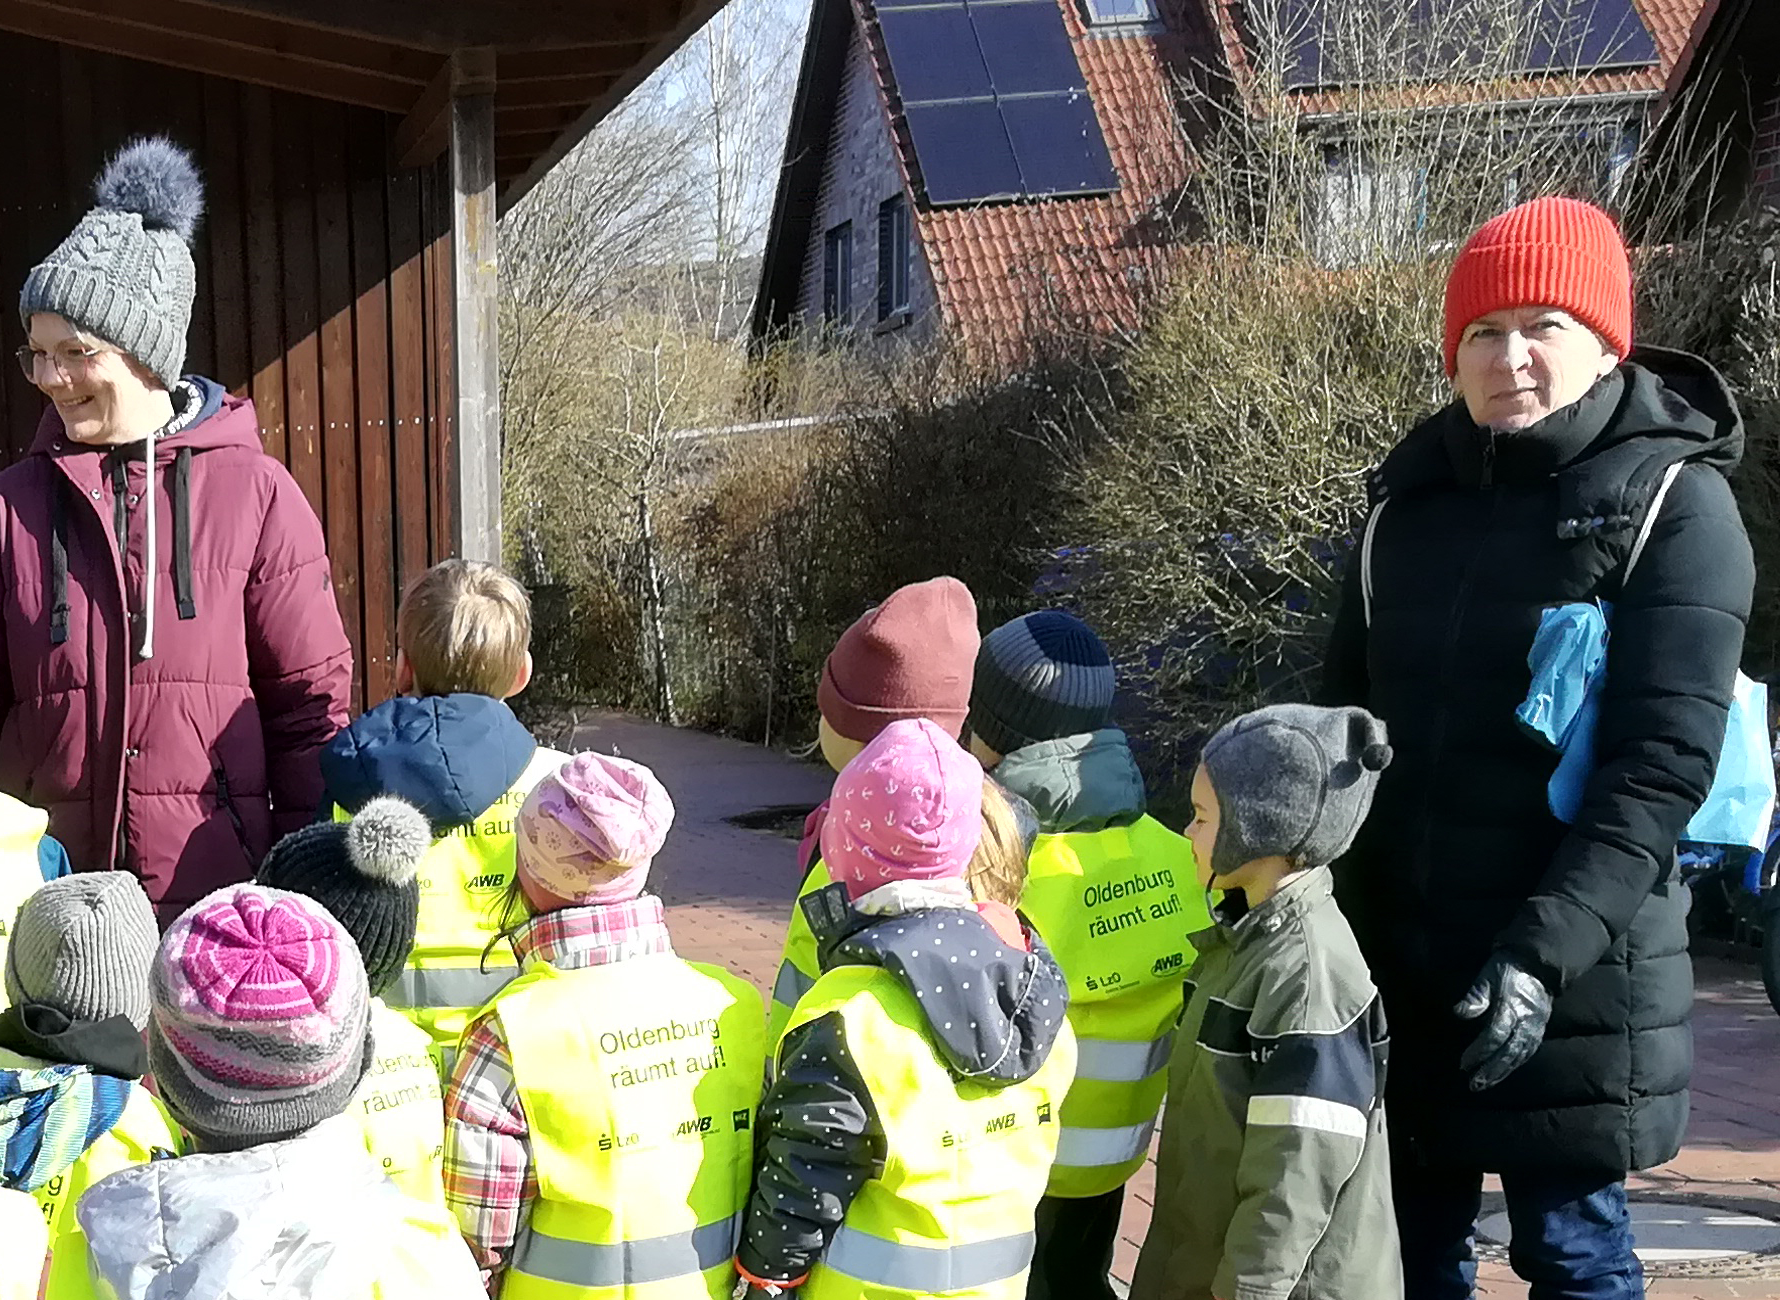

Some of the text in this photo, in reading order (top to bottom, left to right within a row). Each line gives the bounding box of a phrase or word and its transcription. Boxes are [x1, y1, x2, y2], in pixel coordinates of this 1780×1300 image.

[467, 874, 505, 889] AWB
[1084, 869, 1175, 908] Oldenburg
[1089, 893, 1183, 938] räumt auf!
[1153, 952, 1183, 973] AWB
[600, 1018, 720, 1055] Oldenburg
[610, 1045, 727, 1089] räumt auf!
[676, 1116, 713, 1137] AWB
[985, 1112, 1016, 1135] AWB
